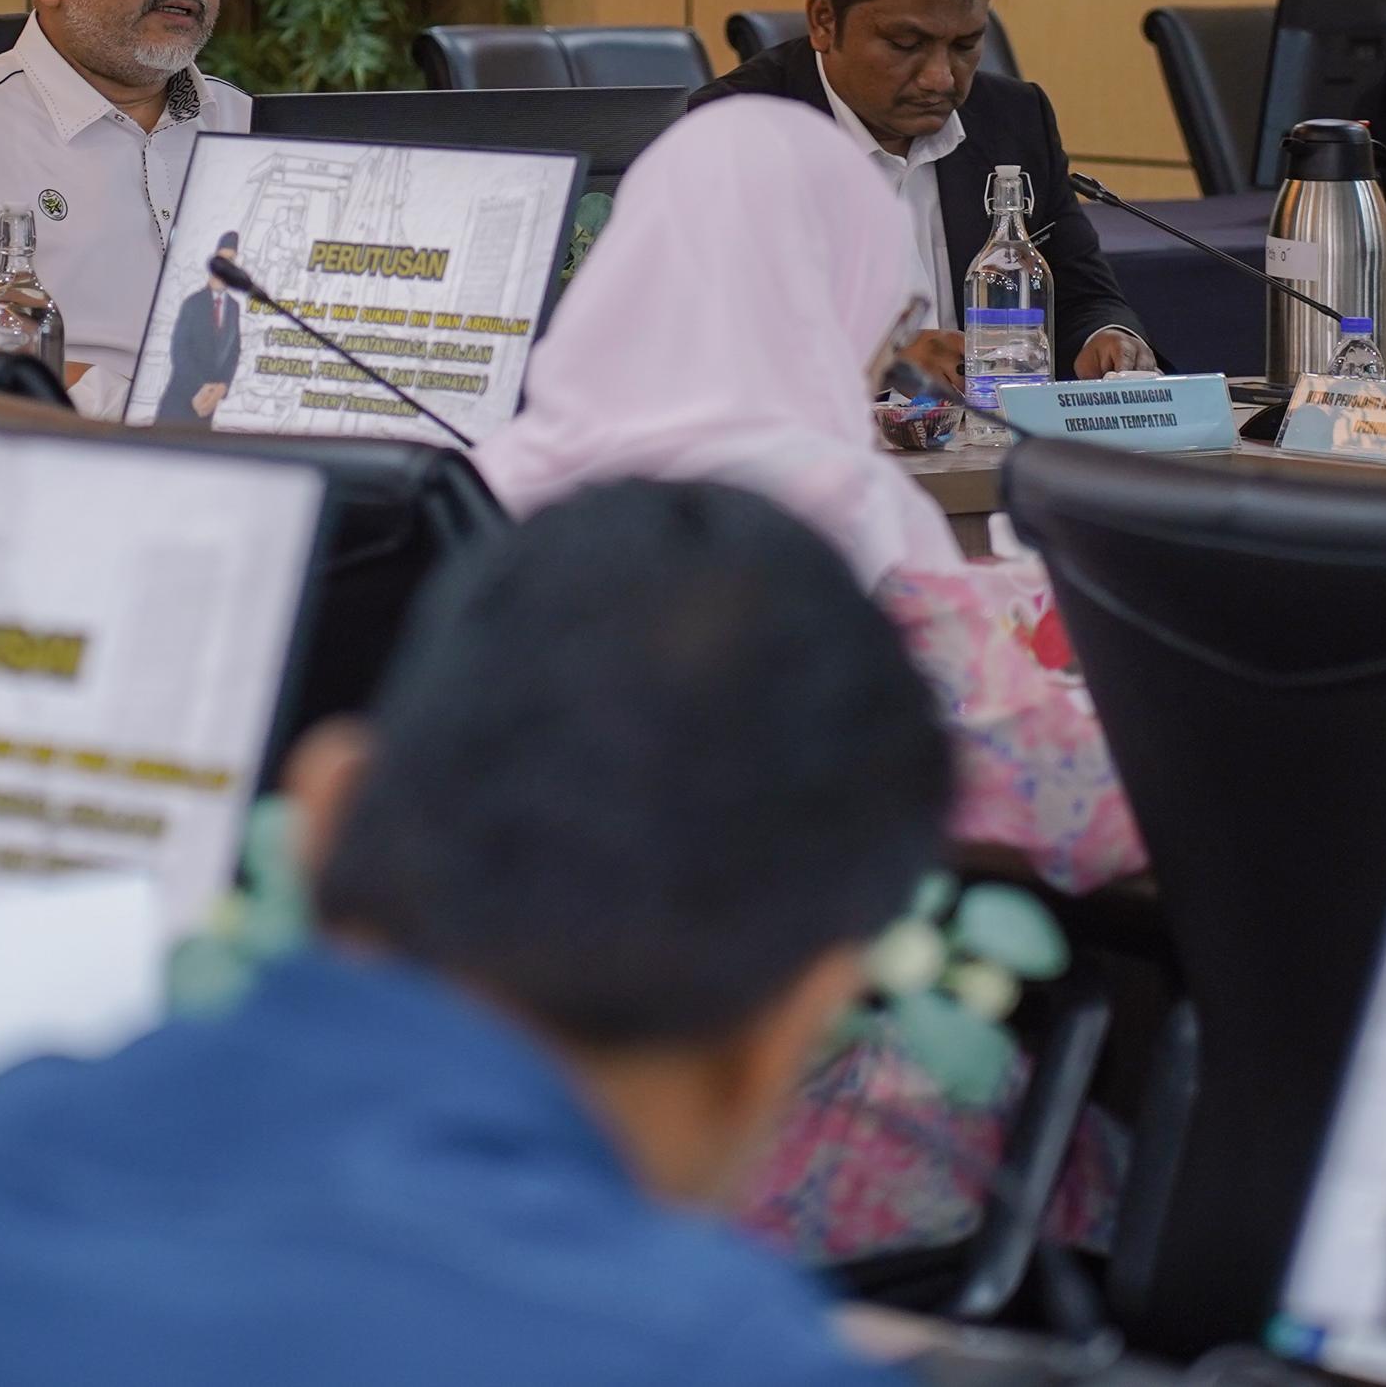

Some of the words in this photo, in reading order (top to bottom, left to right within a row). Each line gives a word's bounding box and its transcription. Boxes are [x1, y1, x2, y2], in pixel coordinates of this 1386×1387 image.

[307, 240, 450, 282] PERUTUSAN
[299, 301, 328, 319] HAJI
[331, 303, 358, 321] WAN
[408, 309, 430, 327] BIN
[433, 311, 461, 329] WAN
[463, 314, 531, 335] ABDULLAH
[337, 333, 426, 359] JAWATANKUASA
[427, 340, 494, 364] KERAJAAN
[389, 367, 417, 388] DAN
[415, 369, 482, 393] KESIHATAN
[300, 389, 342, 411] NEGERI
[1057, 389, 1121, 408] SETIAUSAHA
[1122, 388, 1173, 405] BAHAGIAN
